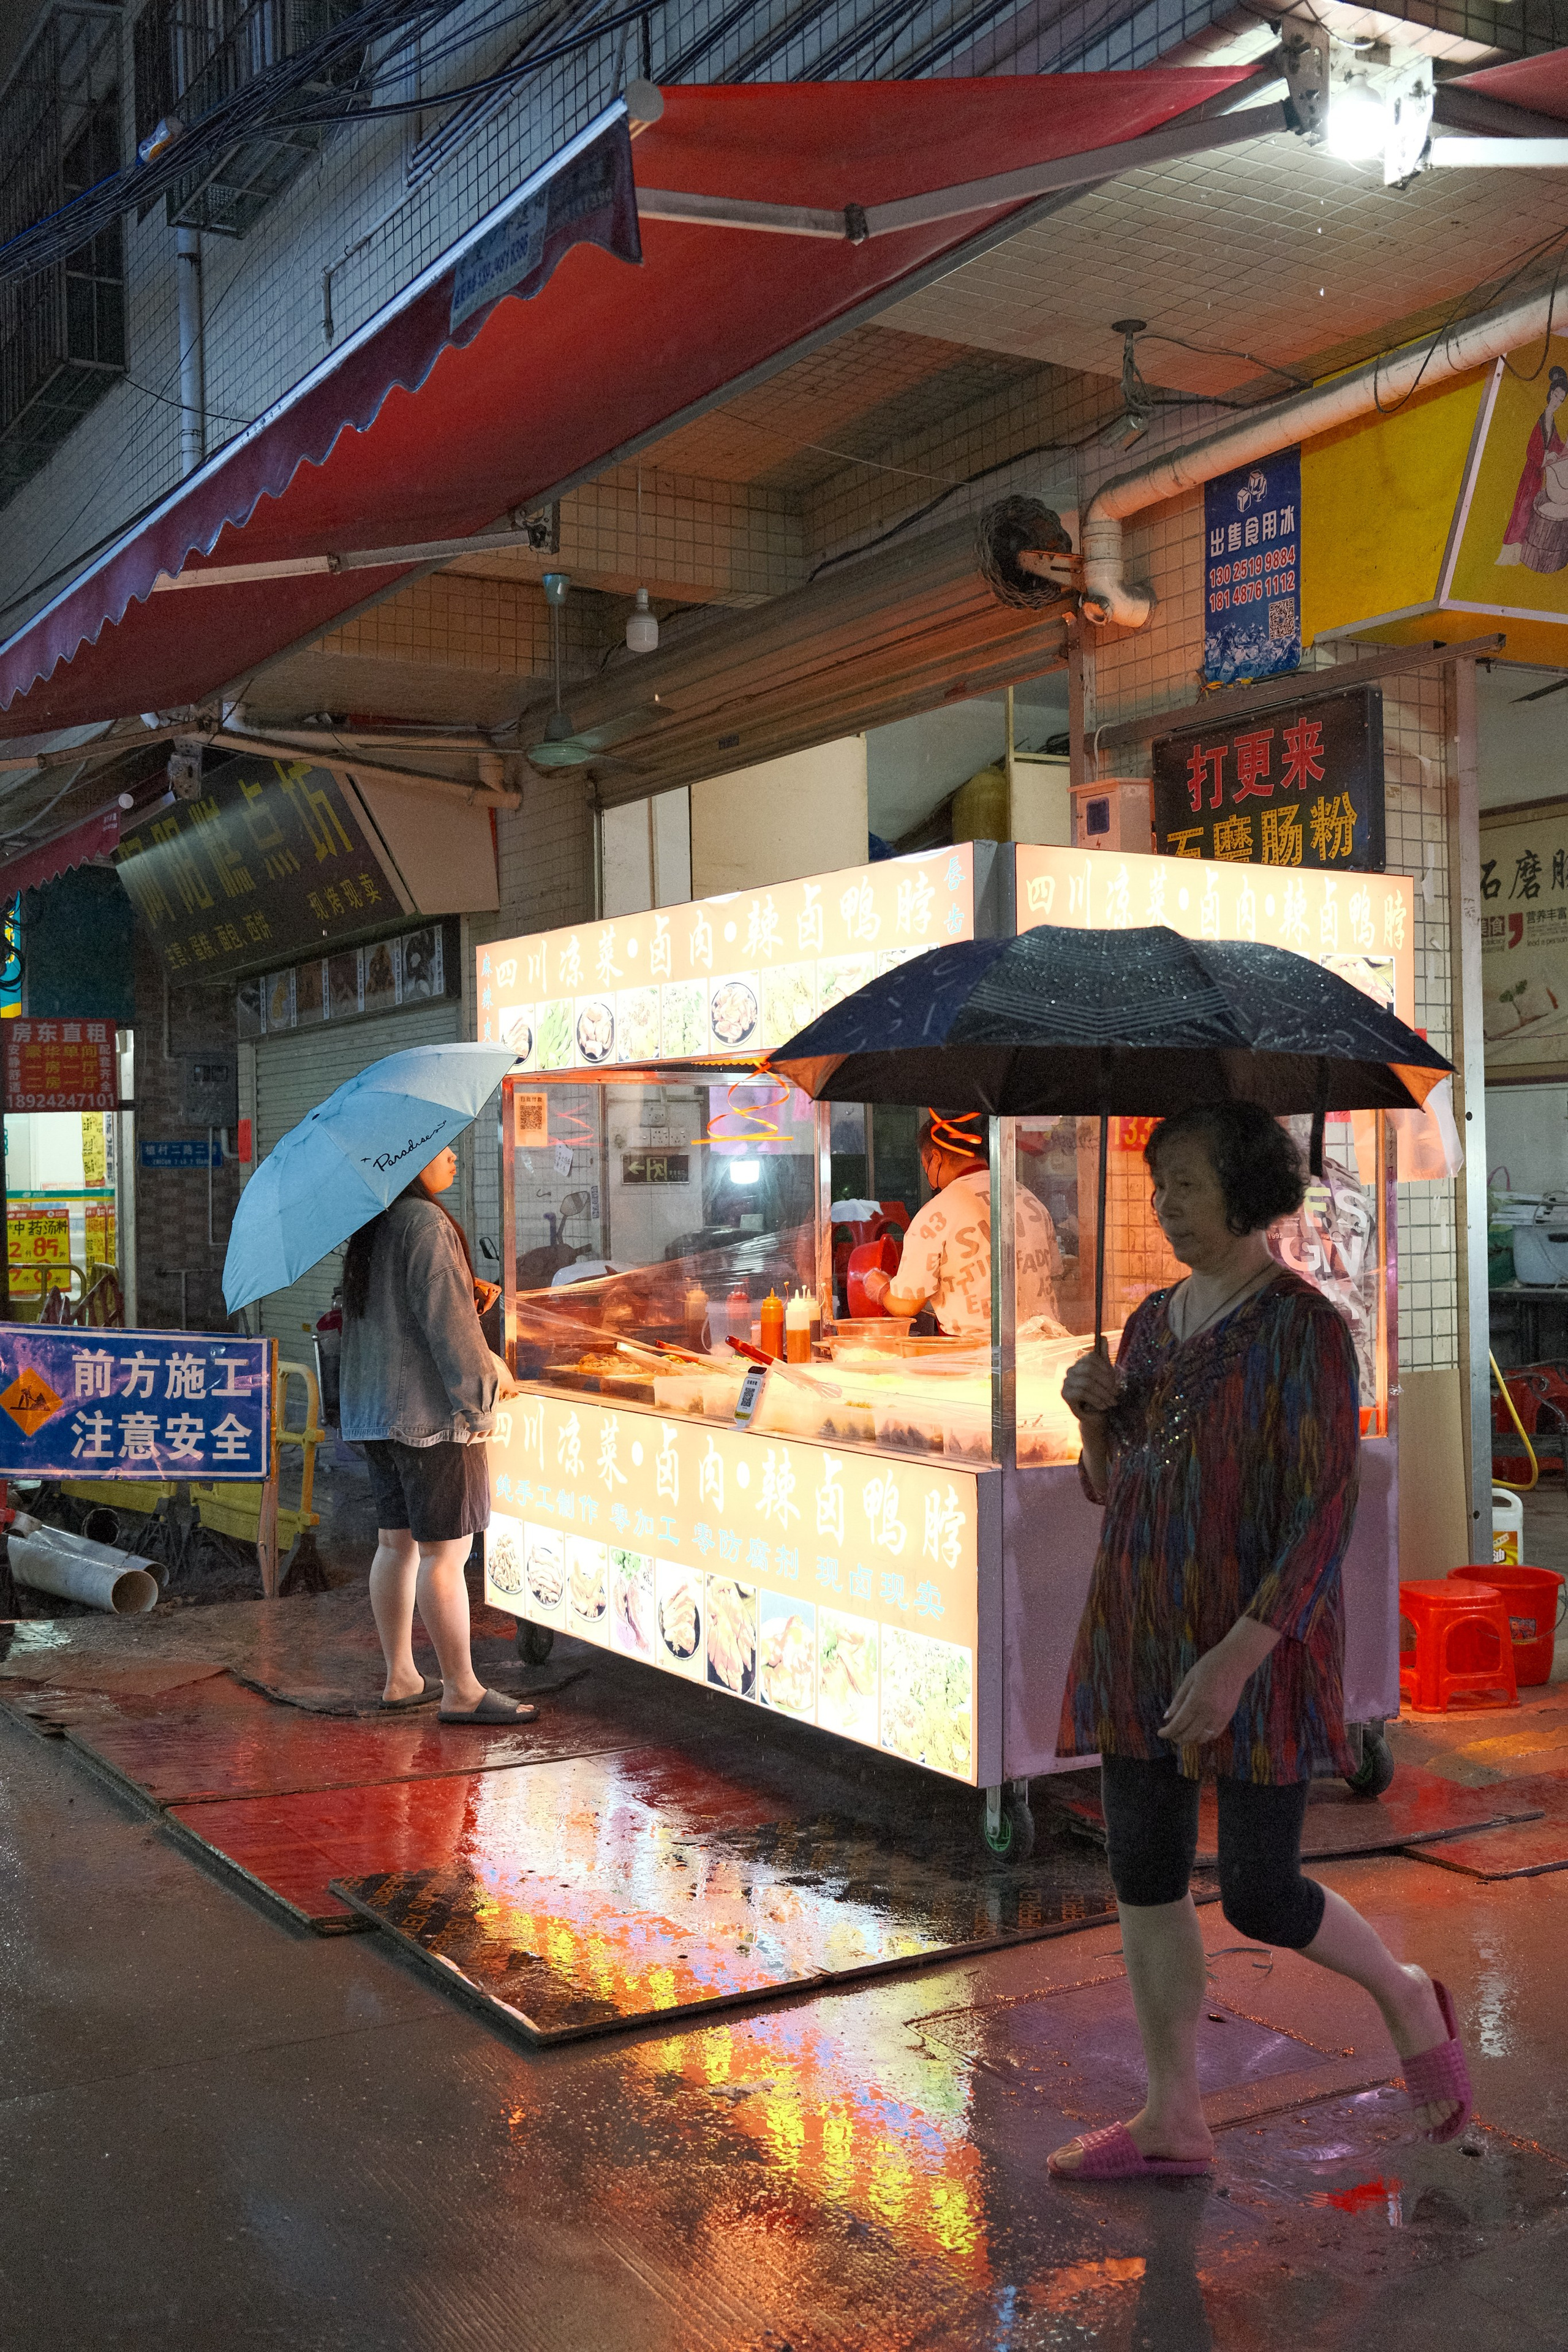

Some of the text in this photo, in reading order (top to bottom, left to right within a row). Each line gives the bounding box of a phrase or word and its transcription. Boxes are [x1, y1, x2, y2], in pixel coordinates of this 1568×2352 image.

[1210, 505, 1295, 558] 出售食用冰
[1209, 545, 1295, 589] 130 2519 9884
[1209, 570, 1295, 612] 181 4876 1112
[1186, 717, 1325, 812] 打更来
[1167, 791, 1358, 867] 石磨肠粉
[12, 1022, 108, 1042] 房东直租
[25, 1076, 98, 1090] 二房一厅
[26, 1061, 98, 1074] 一房一厅
[98, 1044, 112, 1092] 配套齐全
[6, 1093, 115, 1109] 18924247101
[14, 1221, 69, 1236] 中药汤料
[72, 1348, 252, 1400] 前方施工
[70, 1409, 252, 1461] 注意安全
[496, 1474, 946, 1619] 纯手工制作 零加工 零防腐剂 现卤现卖
